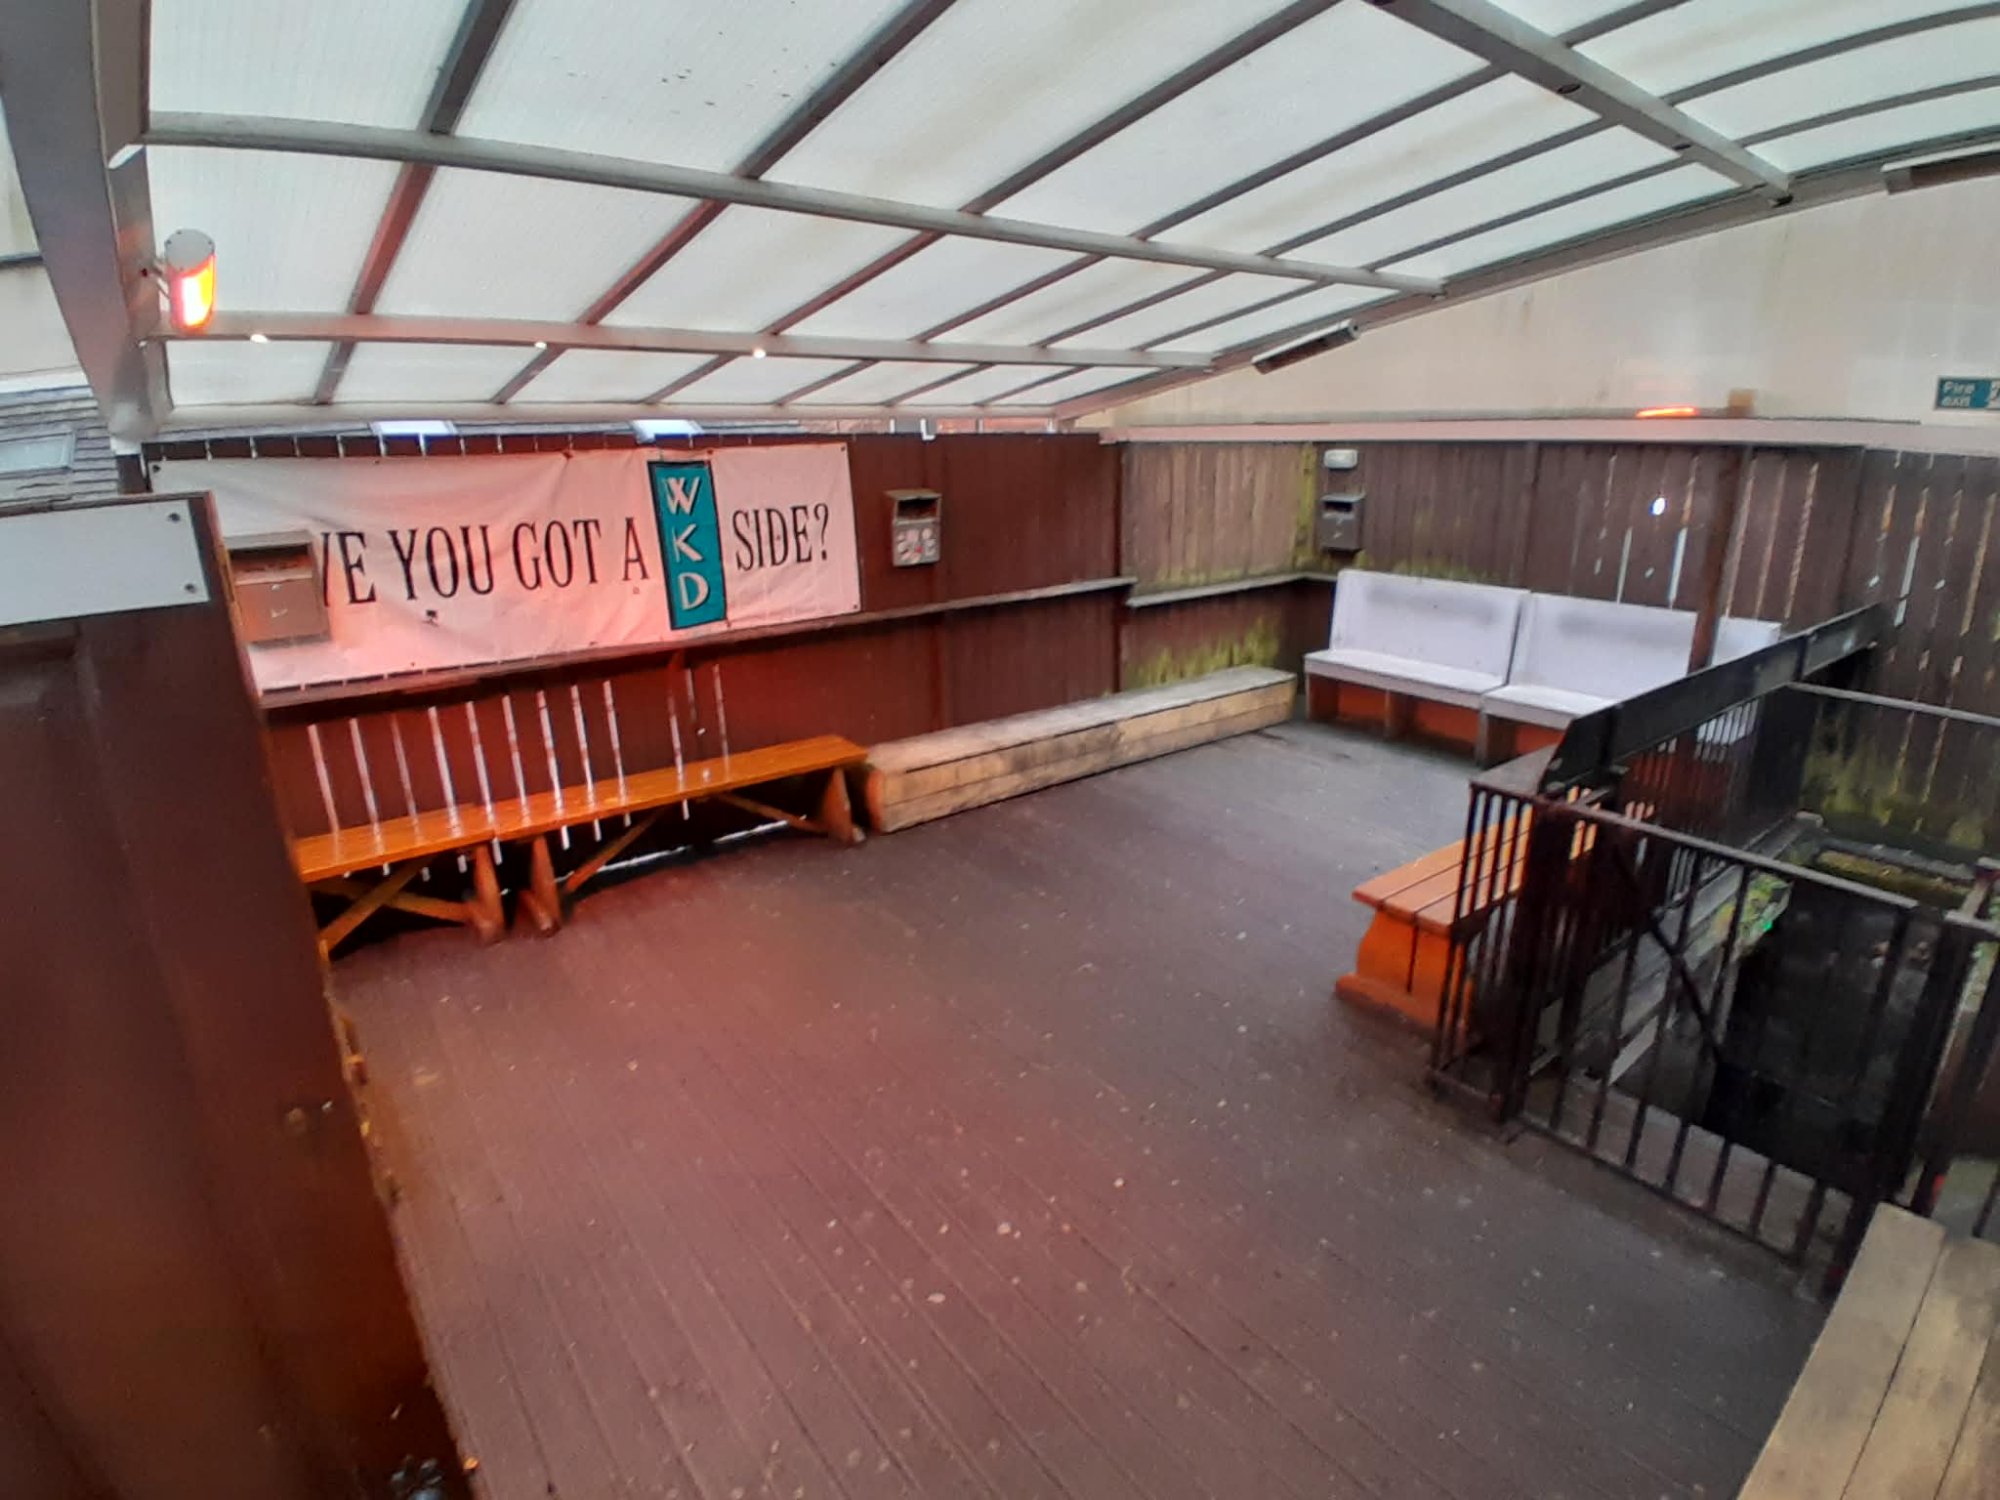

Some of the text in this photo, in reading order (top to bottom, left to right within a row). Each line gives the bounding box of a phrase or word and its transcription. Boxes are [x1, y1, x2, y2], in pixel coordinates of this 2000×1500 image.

[1942, 381, 1976, 394] Fire
[387, 524, 494, 600] YOU
[512, 518, 602, 591] GOT
[622, 516, 649, 582] A
[664, 476, 710, 612] WKD
[732, 502, 830, 572] SIDE?
